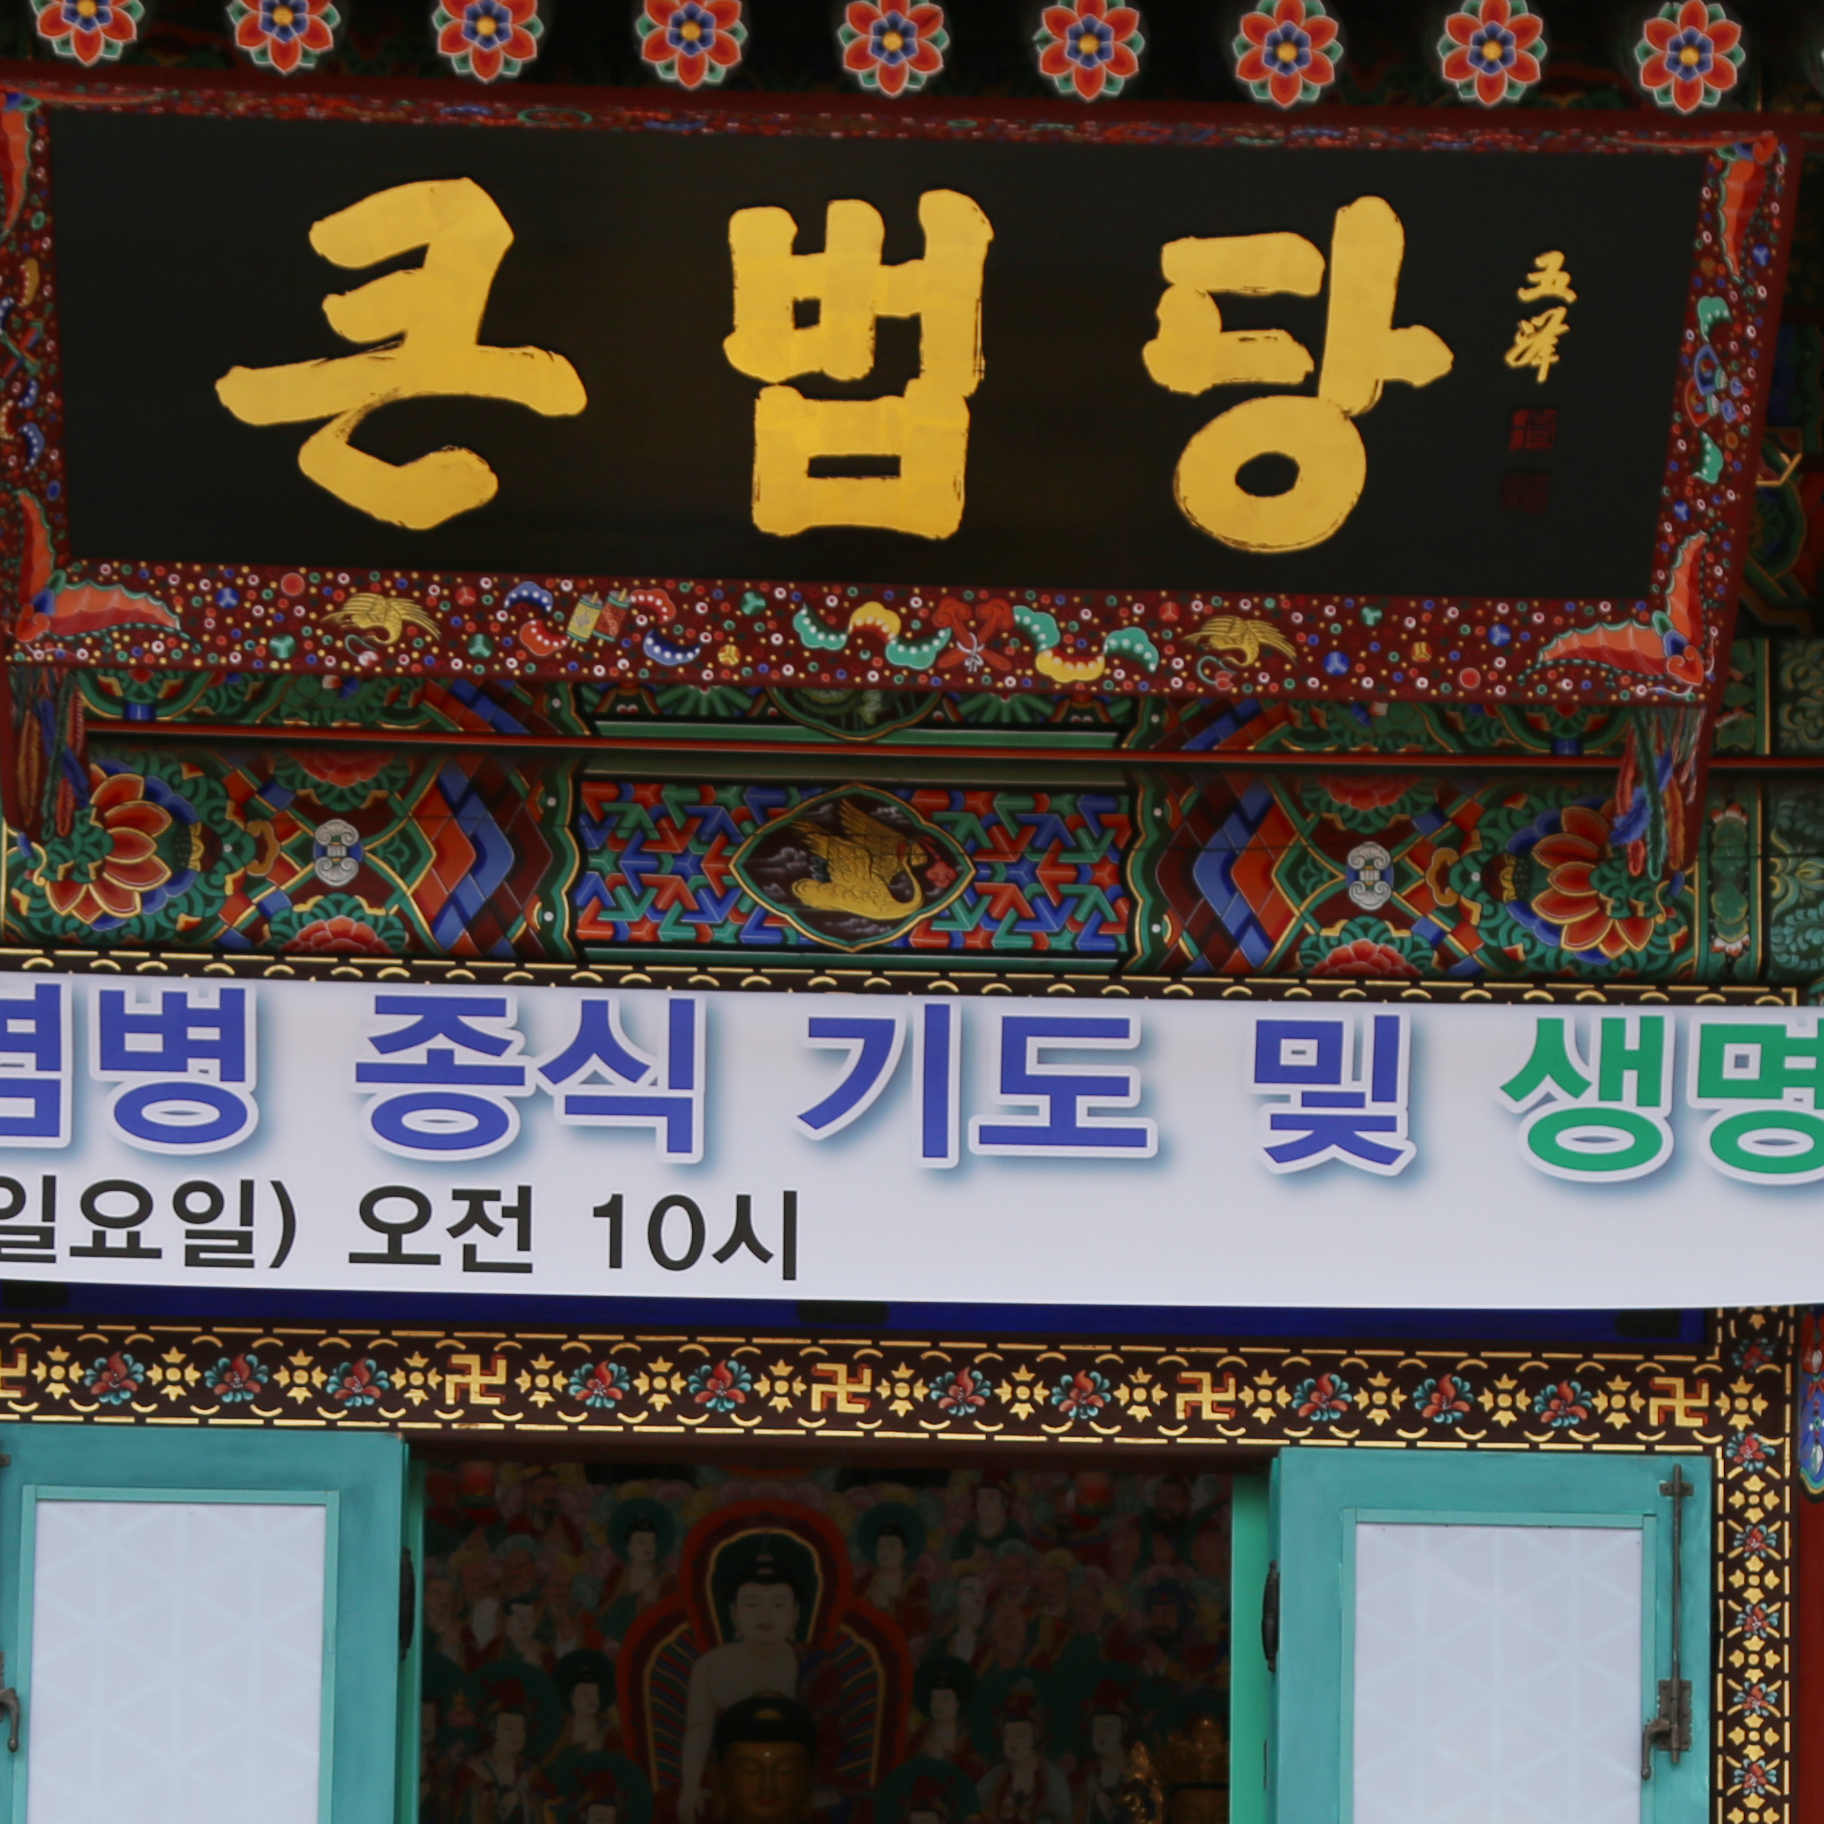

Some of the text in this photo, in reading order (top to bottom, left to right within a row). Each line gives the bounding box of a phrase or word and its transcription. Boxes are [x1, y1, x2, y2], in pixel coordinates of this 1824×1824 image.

[356, 995, 695, 1154] 종식
[798, 1003, 1148, 1159] 기도
[1254, 1015, 1403, 1166] 및
[347, 1184, 534, 1275] 오전
[592, 1189, 801, 1282] 10시
